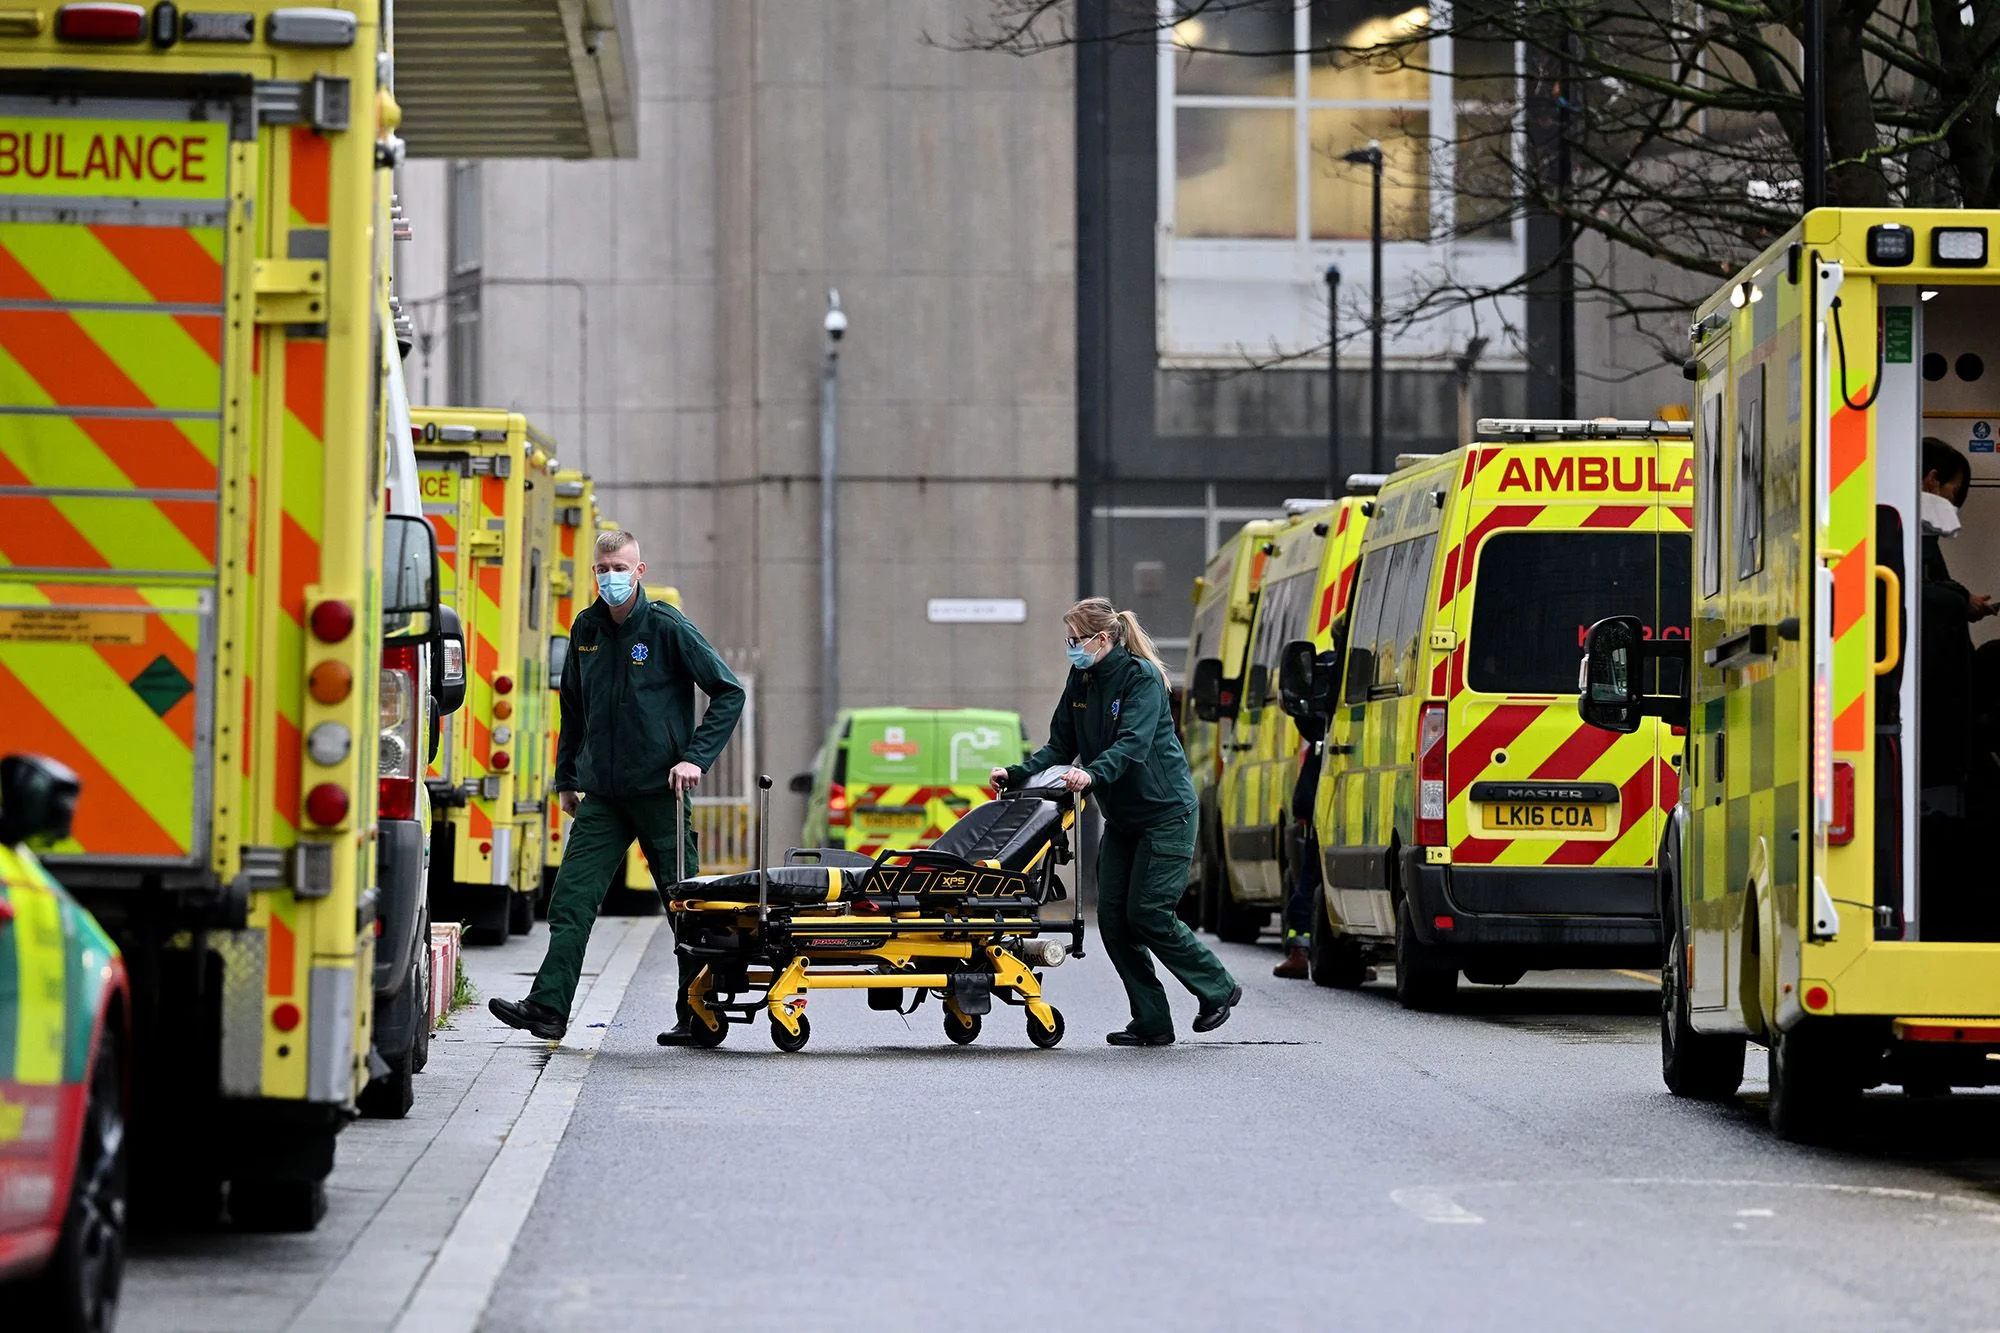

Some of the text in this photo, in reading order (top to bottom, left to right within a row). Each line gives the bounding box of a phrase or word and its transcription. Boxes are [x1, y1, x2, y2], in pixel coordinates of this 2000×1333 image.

[0, 132, 207, 182] BULANCE
[1498, 456, 1693, 492] AMBULA
[1507, 788, 1583, 798] MASTER
[1495, 805, 1593, 827] LK16 COA
[942, 876, 966, 888] XPS
